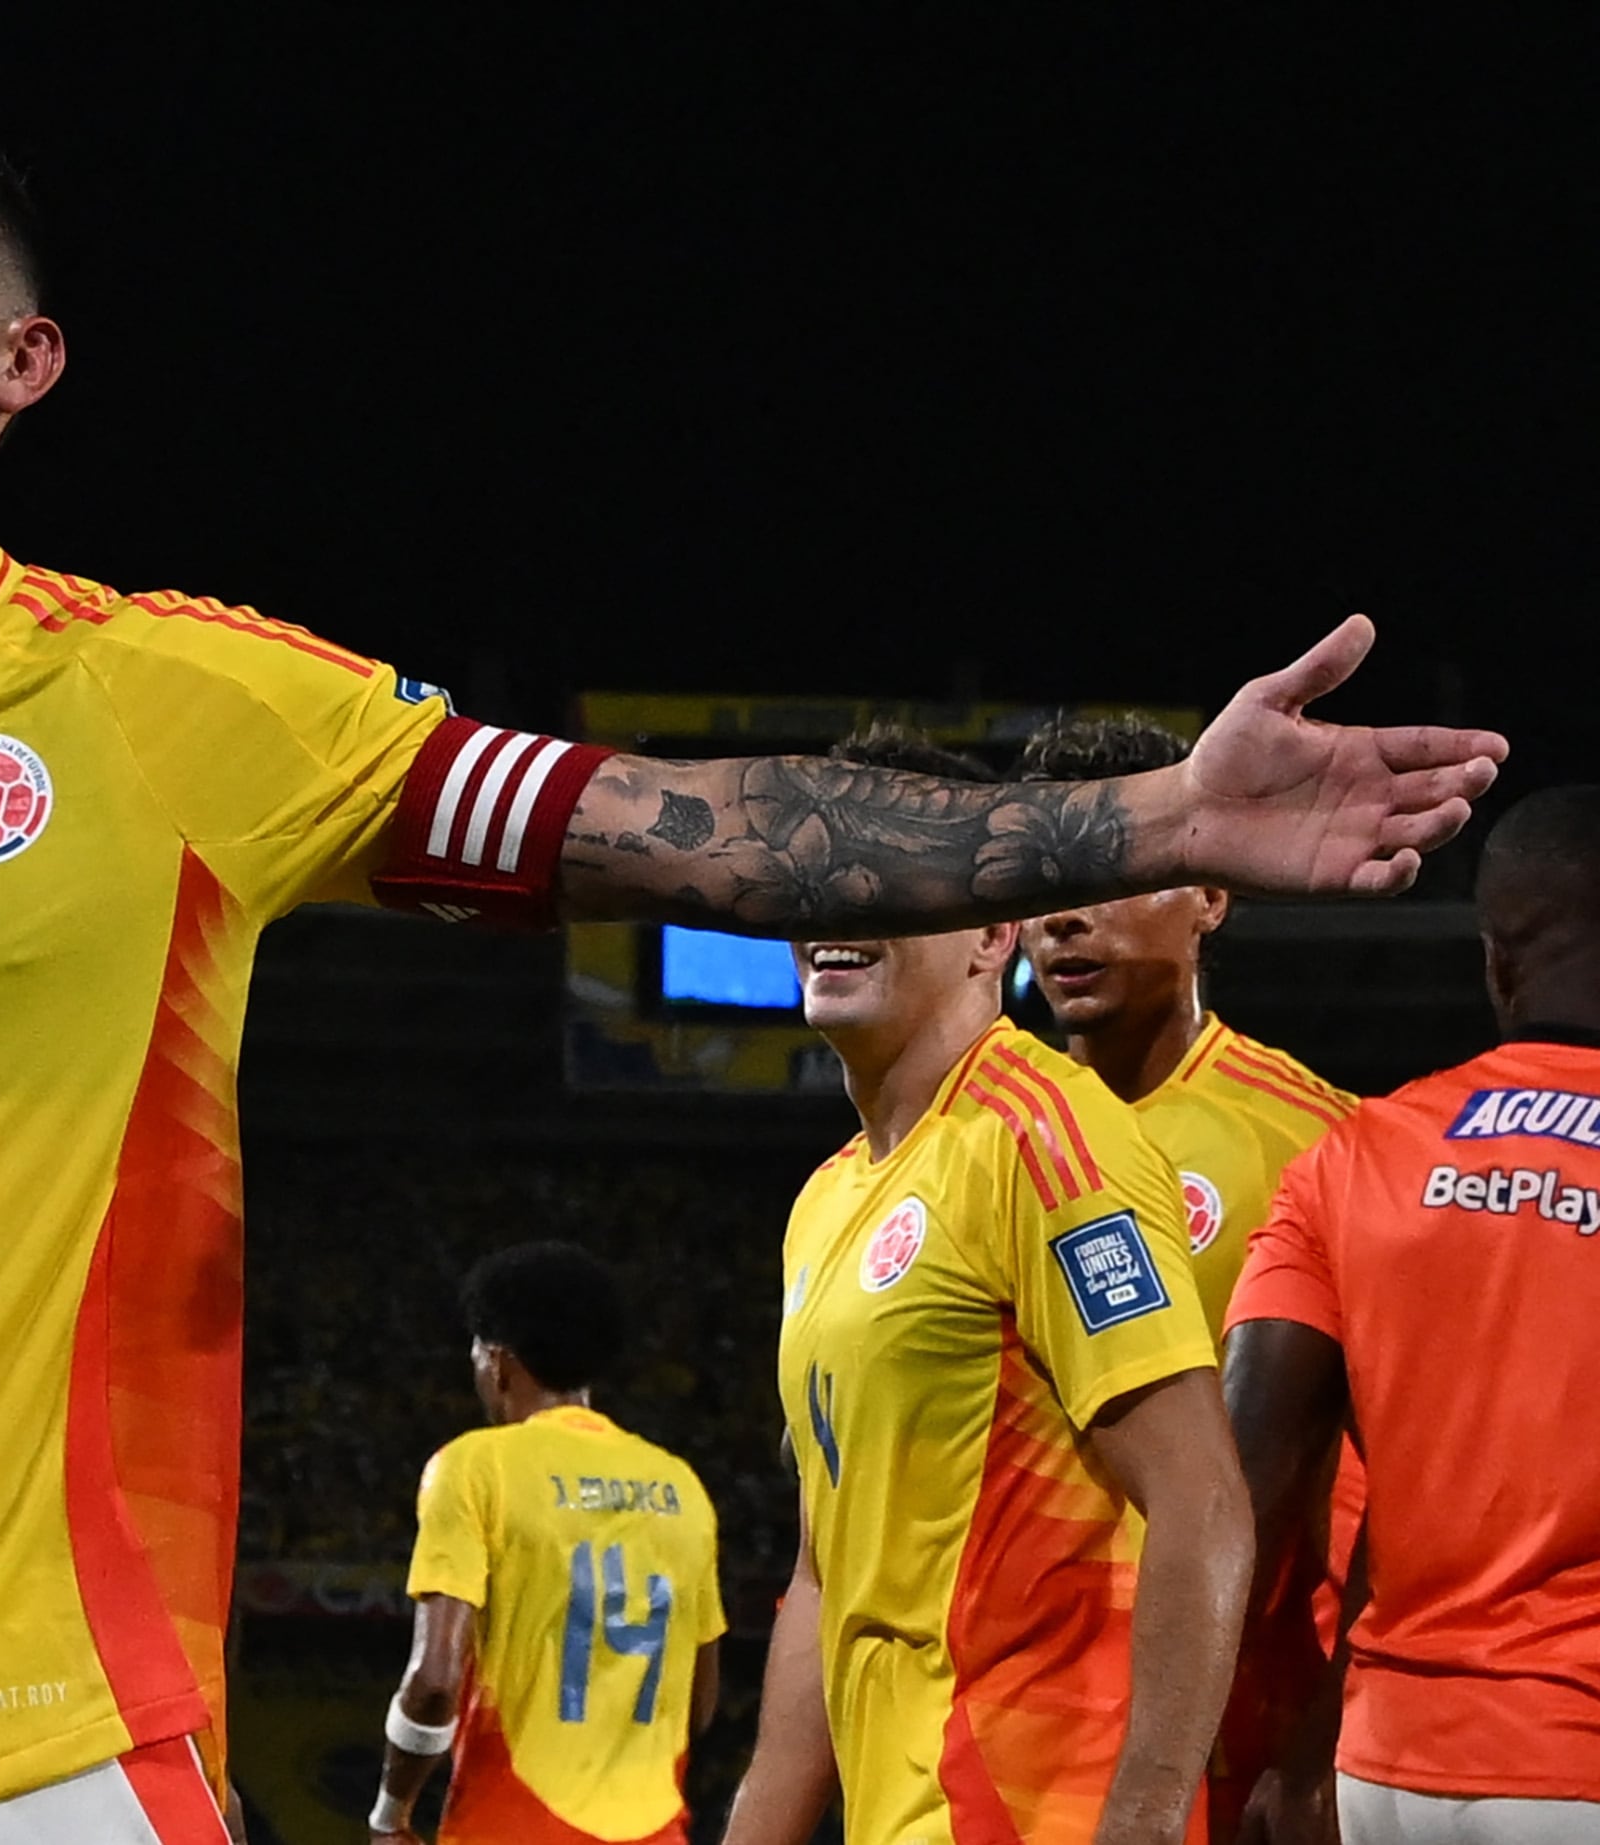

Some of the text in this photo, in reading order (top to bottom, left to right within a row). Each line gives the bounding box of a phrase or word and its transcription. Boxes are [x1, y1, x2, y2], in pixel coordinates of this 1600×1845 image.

[1454, 1090, 1600, 1147] AGUIL
[1422, 1166, 1600, 1236] BetPlay
[1080, 1244, 1133, 1278] UNITES
[558, 1540, 673, 1724] 14
